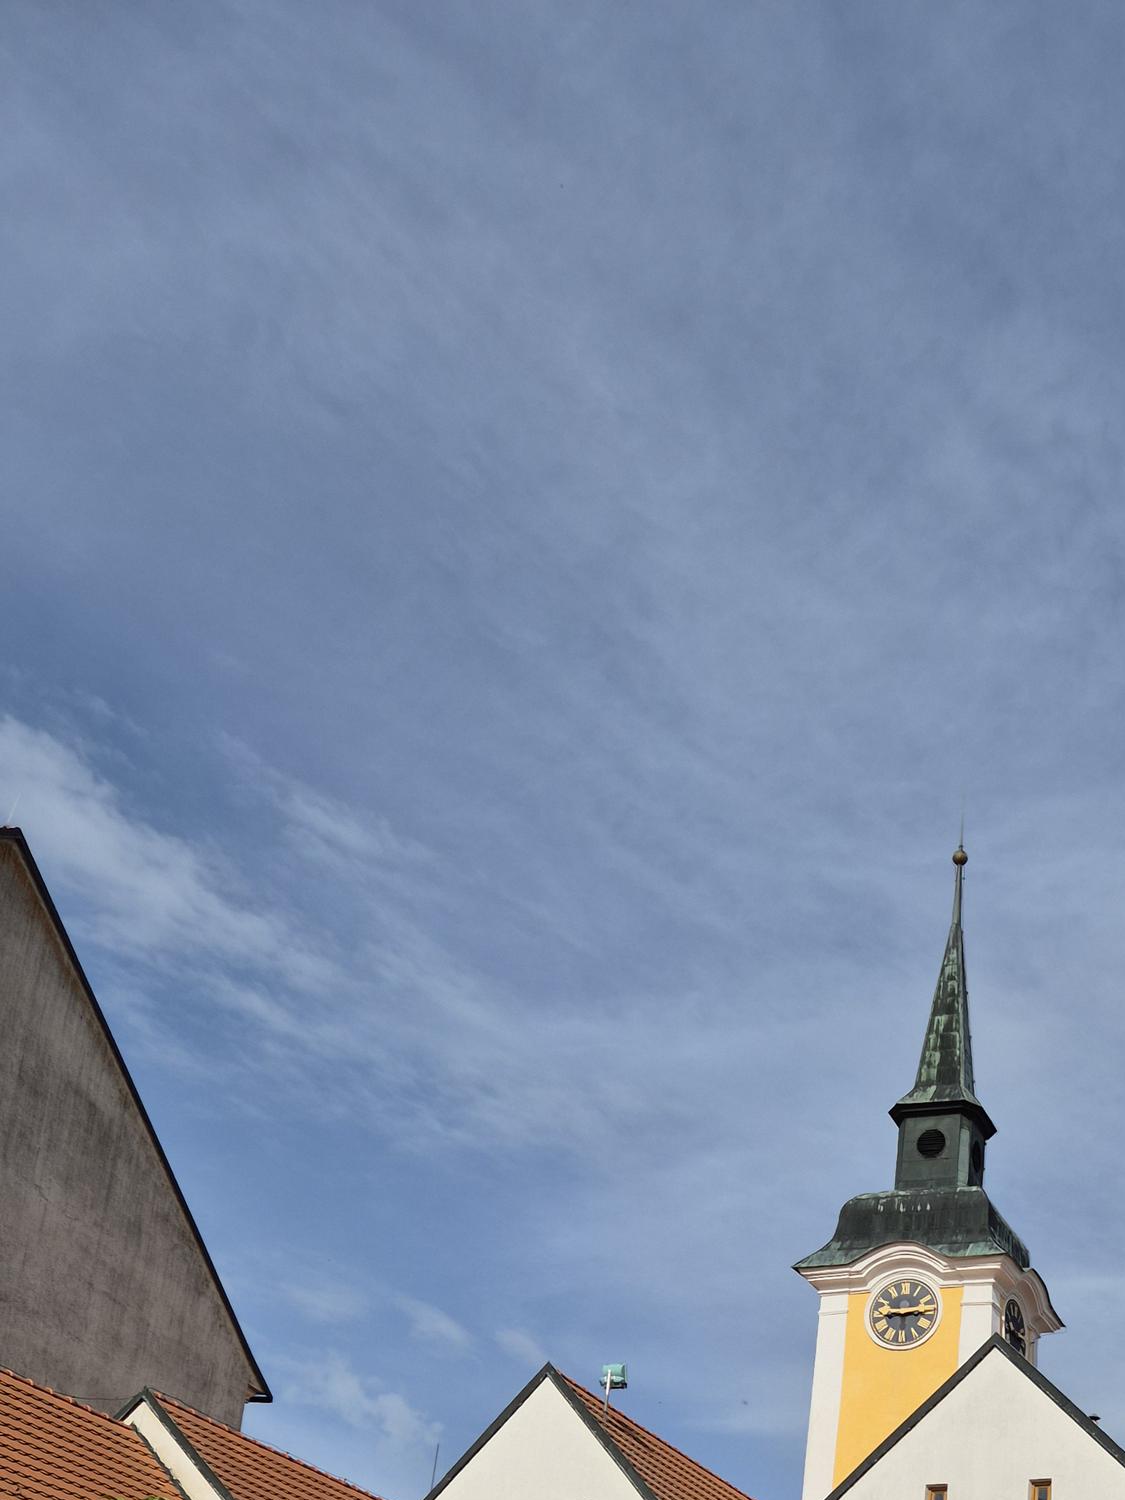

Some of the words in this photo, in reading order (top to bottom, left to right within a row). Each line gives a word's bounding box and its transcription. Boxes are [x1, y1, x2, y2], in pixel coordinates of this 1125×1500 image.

[887, 1286, 898, 1299] XI
[900, 1282, 910, 1295] XII
[913, 1285, 922, 1297] I
[898, 1330, 906, 1342] VI
